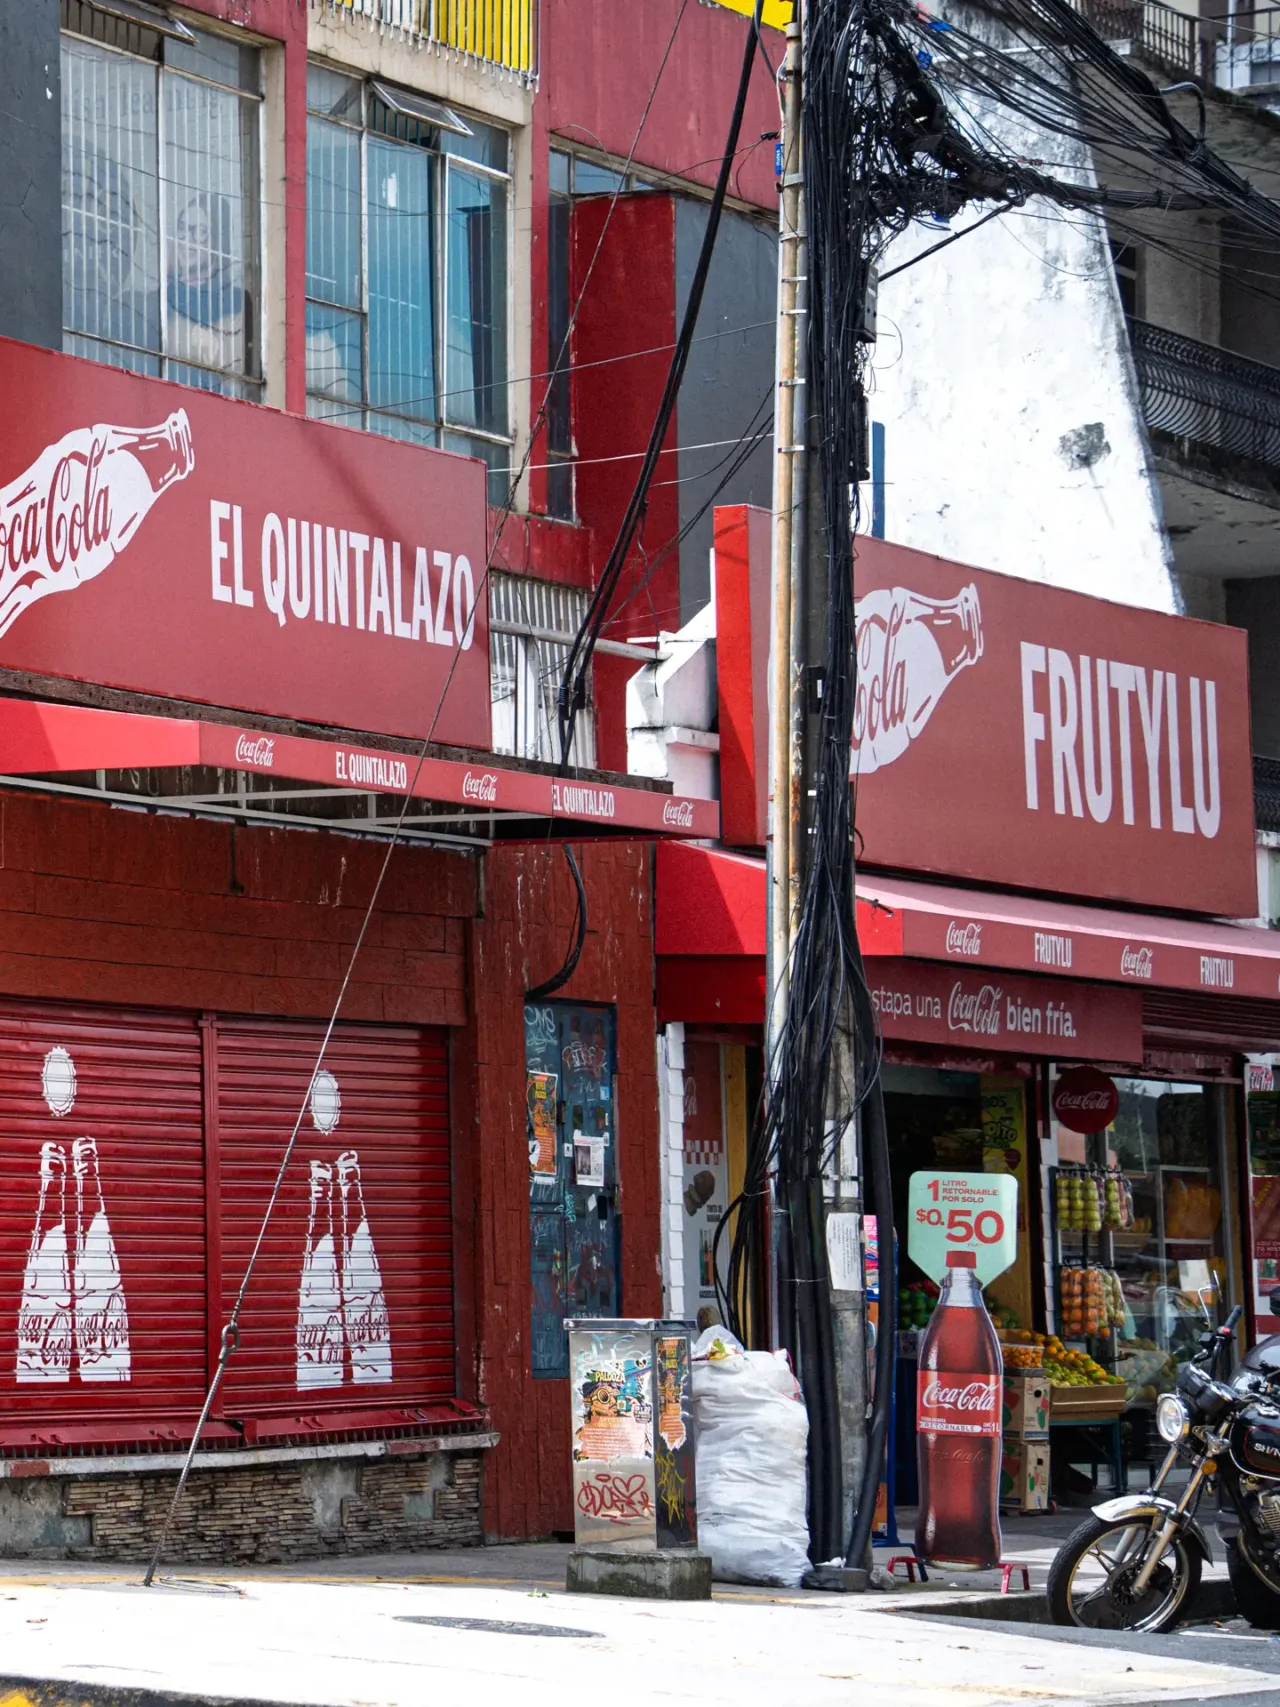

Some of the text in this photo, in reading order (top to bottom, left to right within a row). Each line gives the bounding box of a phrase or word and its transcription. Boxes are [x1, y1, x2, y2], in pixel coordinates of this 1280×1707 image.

[210, 499, 475, 652] EL QUINTALAZO
[235, 734, 275, 767] Coca-Cola
[1020, 641, 1220, 839] FRUTYLU
[335, 751, 407, 789] EL QUINTALAZO
[462, 771, 499, 801] Coca-Cola
[552, 784, 614, 818] EL QUINTALAZO
[662, 799, 694, 827] Coca-Cola
[945, 920, 981, 956] Coca-Cola
[1034, 932, 1072, 968] FRUTYLU
[1120, 945, 1154, 979] Coca-Cola
[1200, 955, 1234, 988] FRUTYLU
[870, 981, 1077, 1038] stapa una Coca-Cola bien fría.
[1056, 1090, 1111, 1110] Coca-Cola
[927, 1179, 940, 1202] 1
[942, 1188, 998, 1196] RETORNABLE
[916, 1208, 1005, 1244] $0.50
[922, 1380, 1000, 1411] Coca-Cola
[924, 1421, 975, 1432] RETORNABLE
